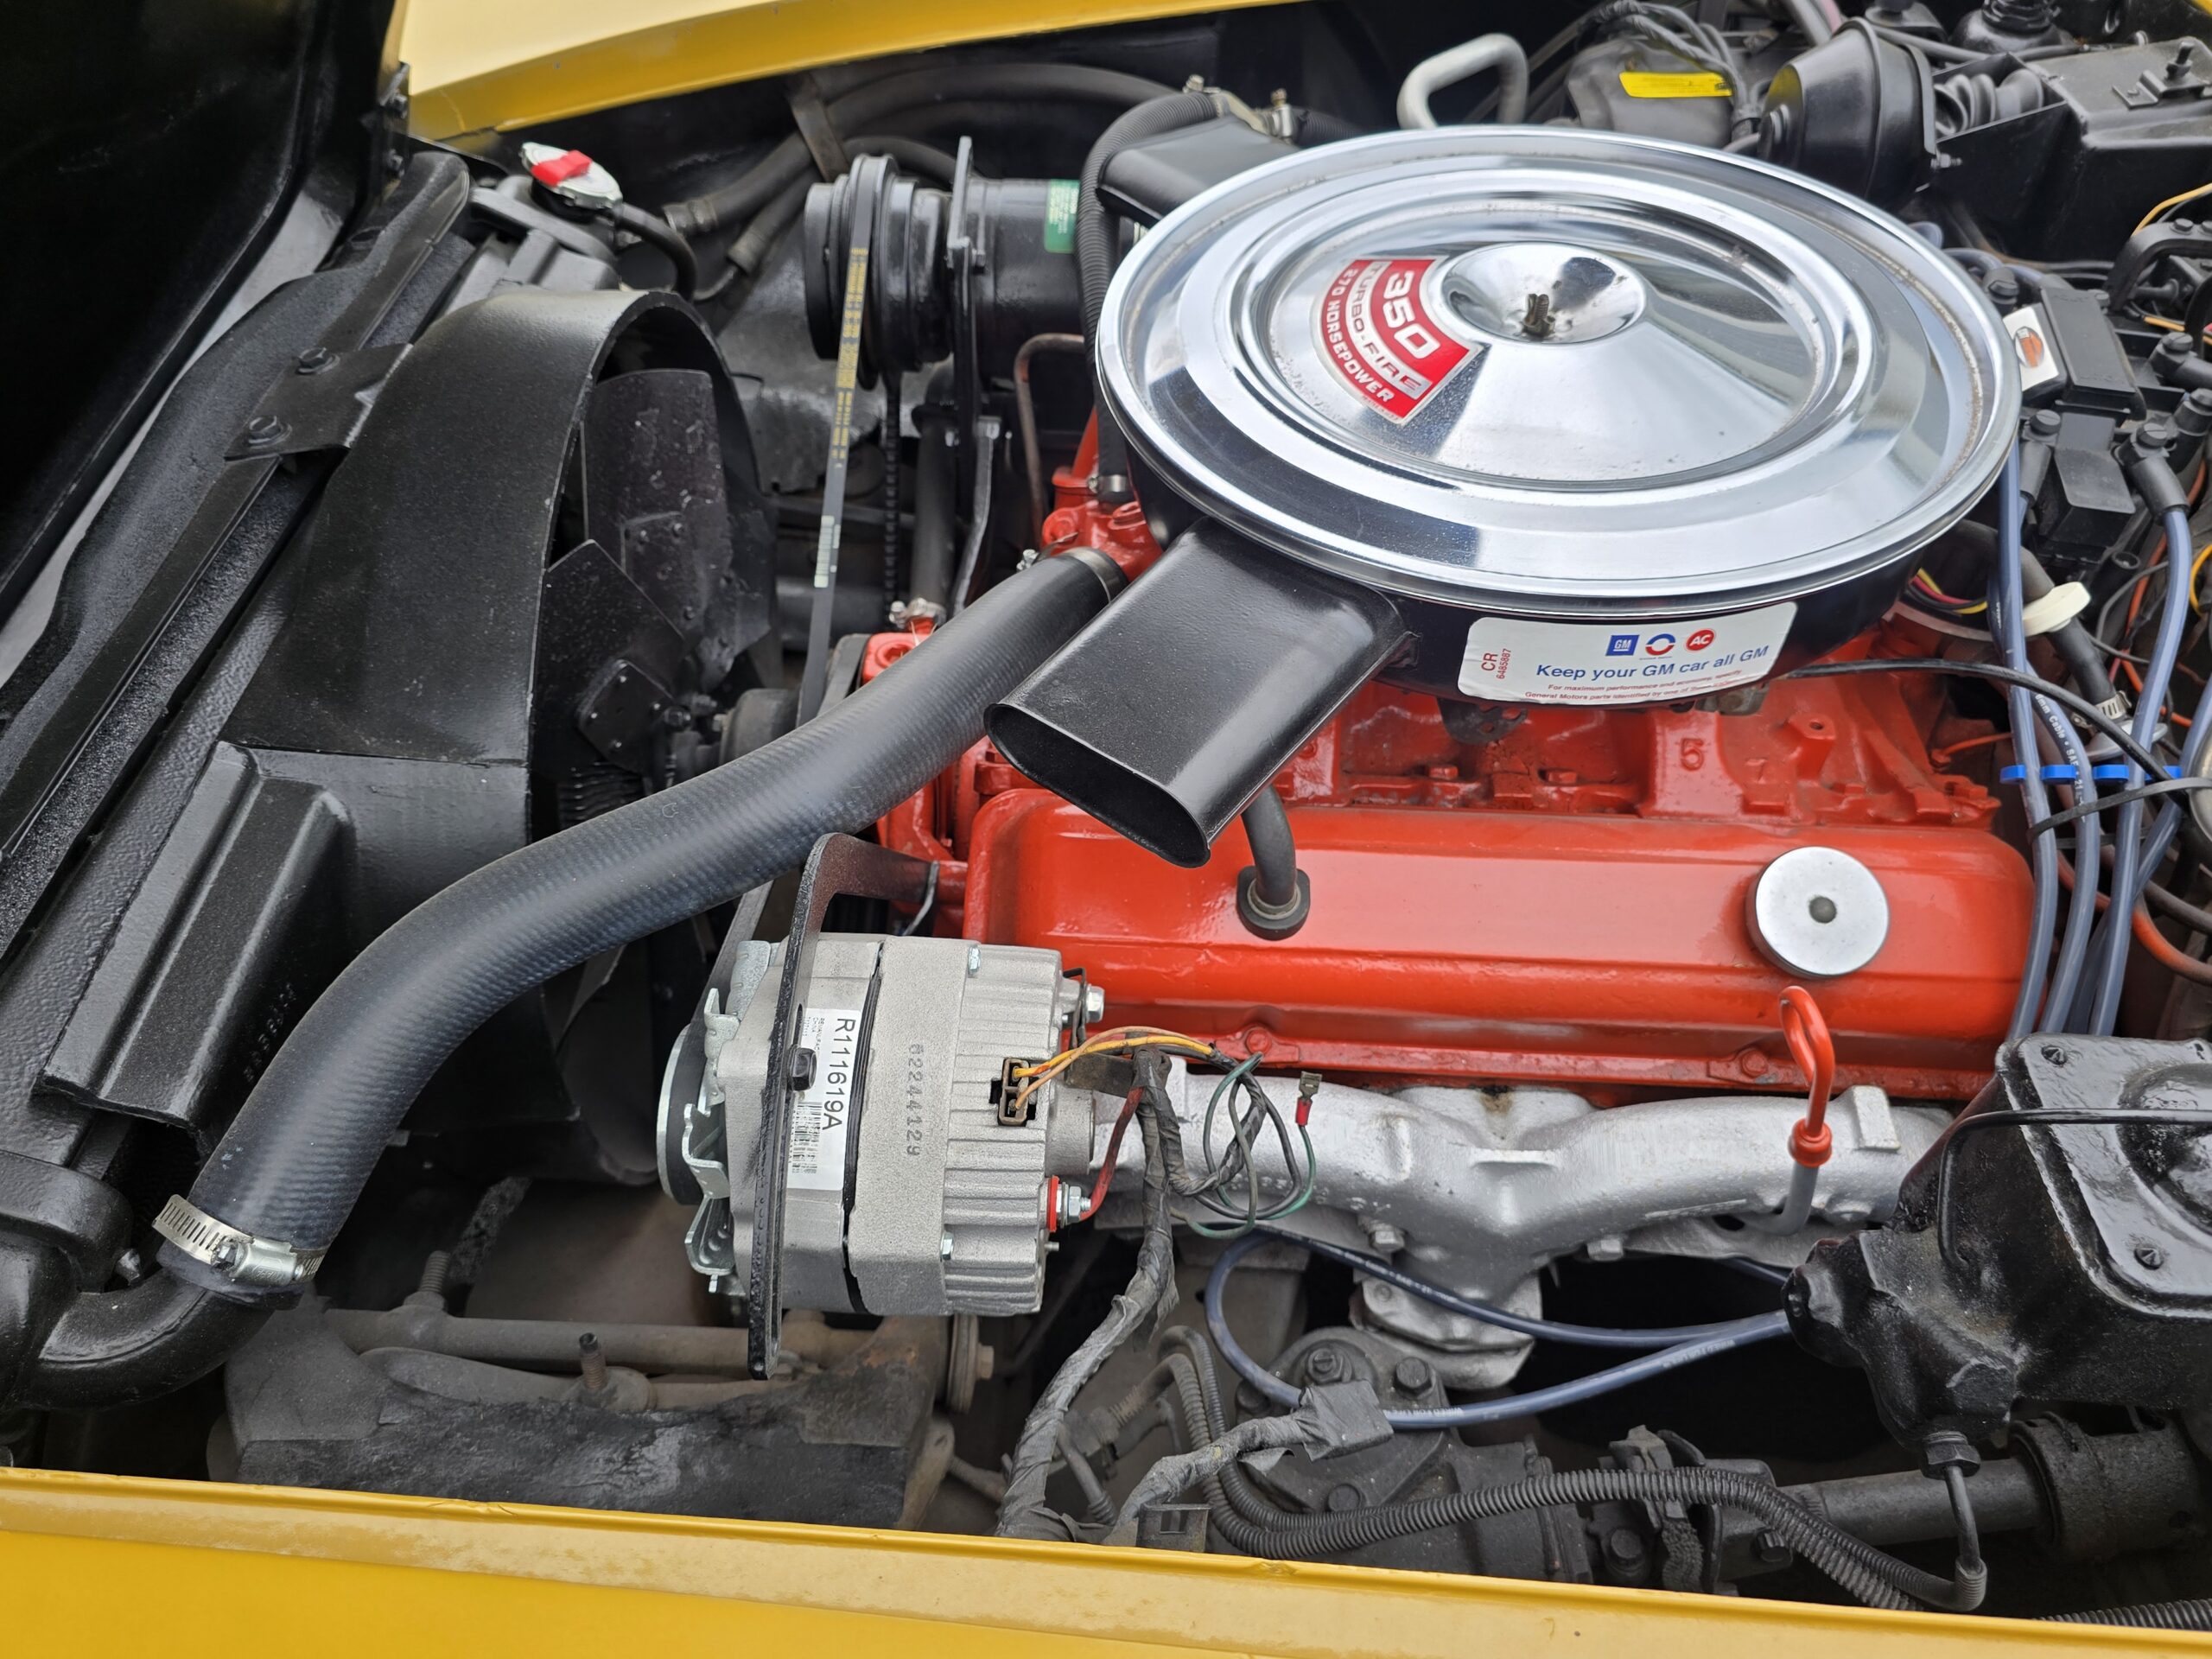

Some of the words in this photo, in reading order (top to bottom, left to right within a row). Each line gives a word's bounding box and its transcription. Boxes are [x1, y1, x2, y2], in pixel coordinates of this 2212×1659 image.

[1332, 269, 1359, 297] 270
[1383, 270, 1441, 359] 350
[1326, 301, 1395, 403] HORSEPOWER
[1481, 652, 1499, 671] CR
[1536, 664, 1586, 681] Keep
[1591, 669, 1637, 681] your
[1643, 663, 1675, 677] GM
[1679, 661, 1709, 673] car
[1713, 653, 1735, 668] all
[1740, 645, 1769, 662] GM
[1680, 737, 1705, 772] 5
[2049, 715, 2066, 739] Cable
[2066, 748, 2080, 767] SAE
[822, 1017, 856, 1131] R111619A
